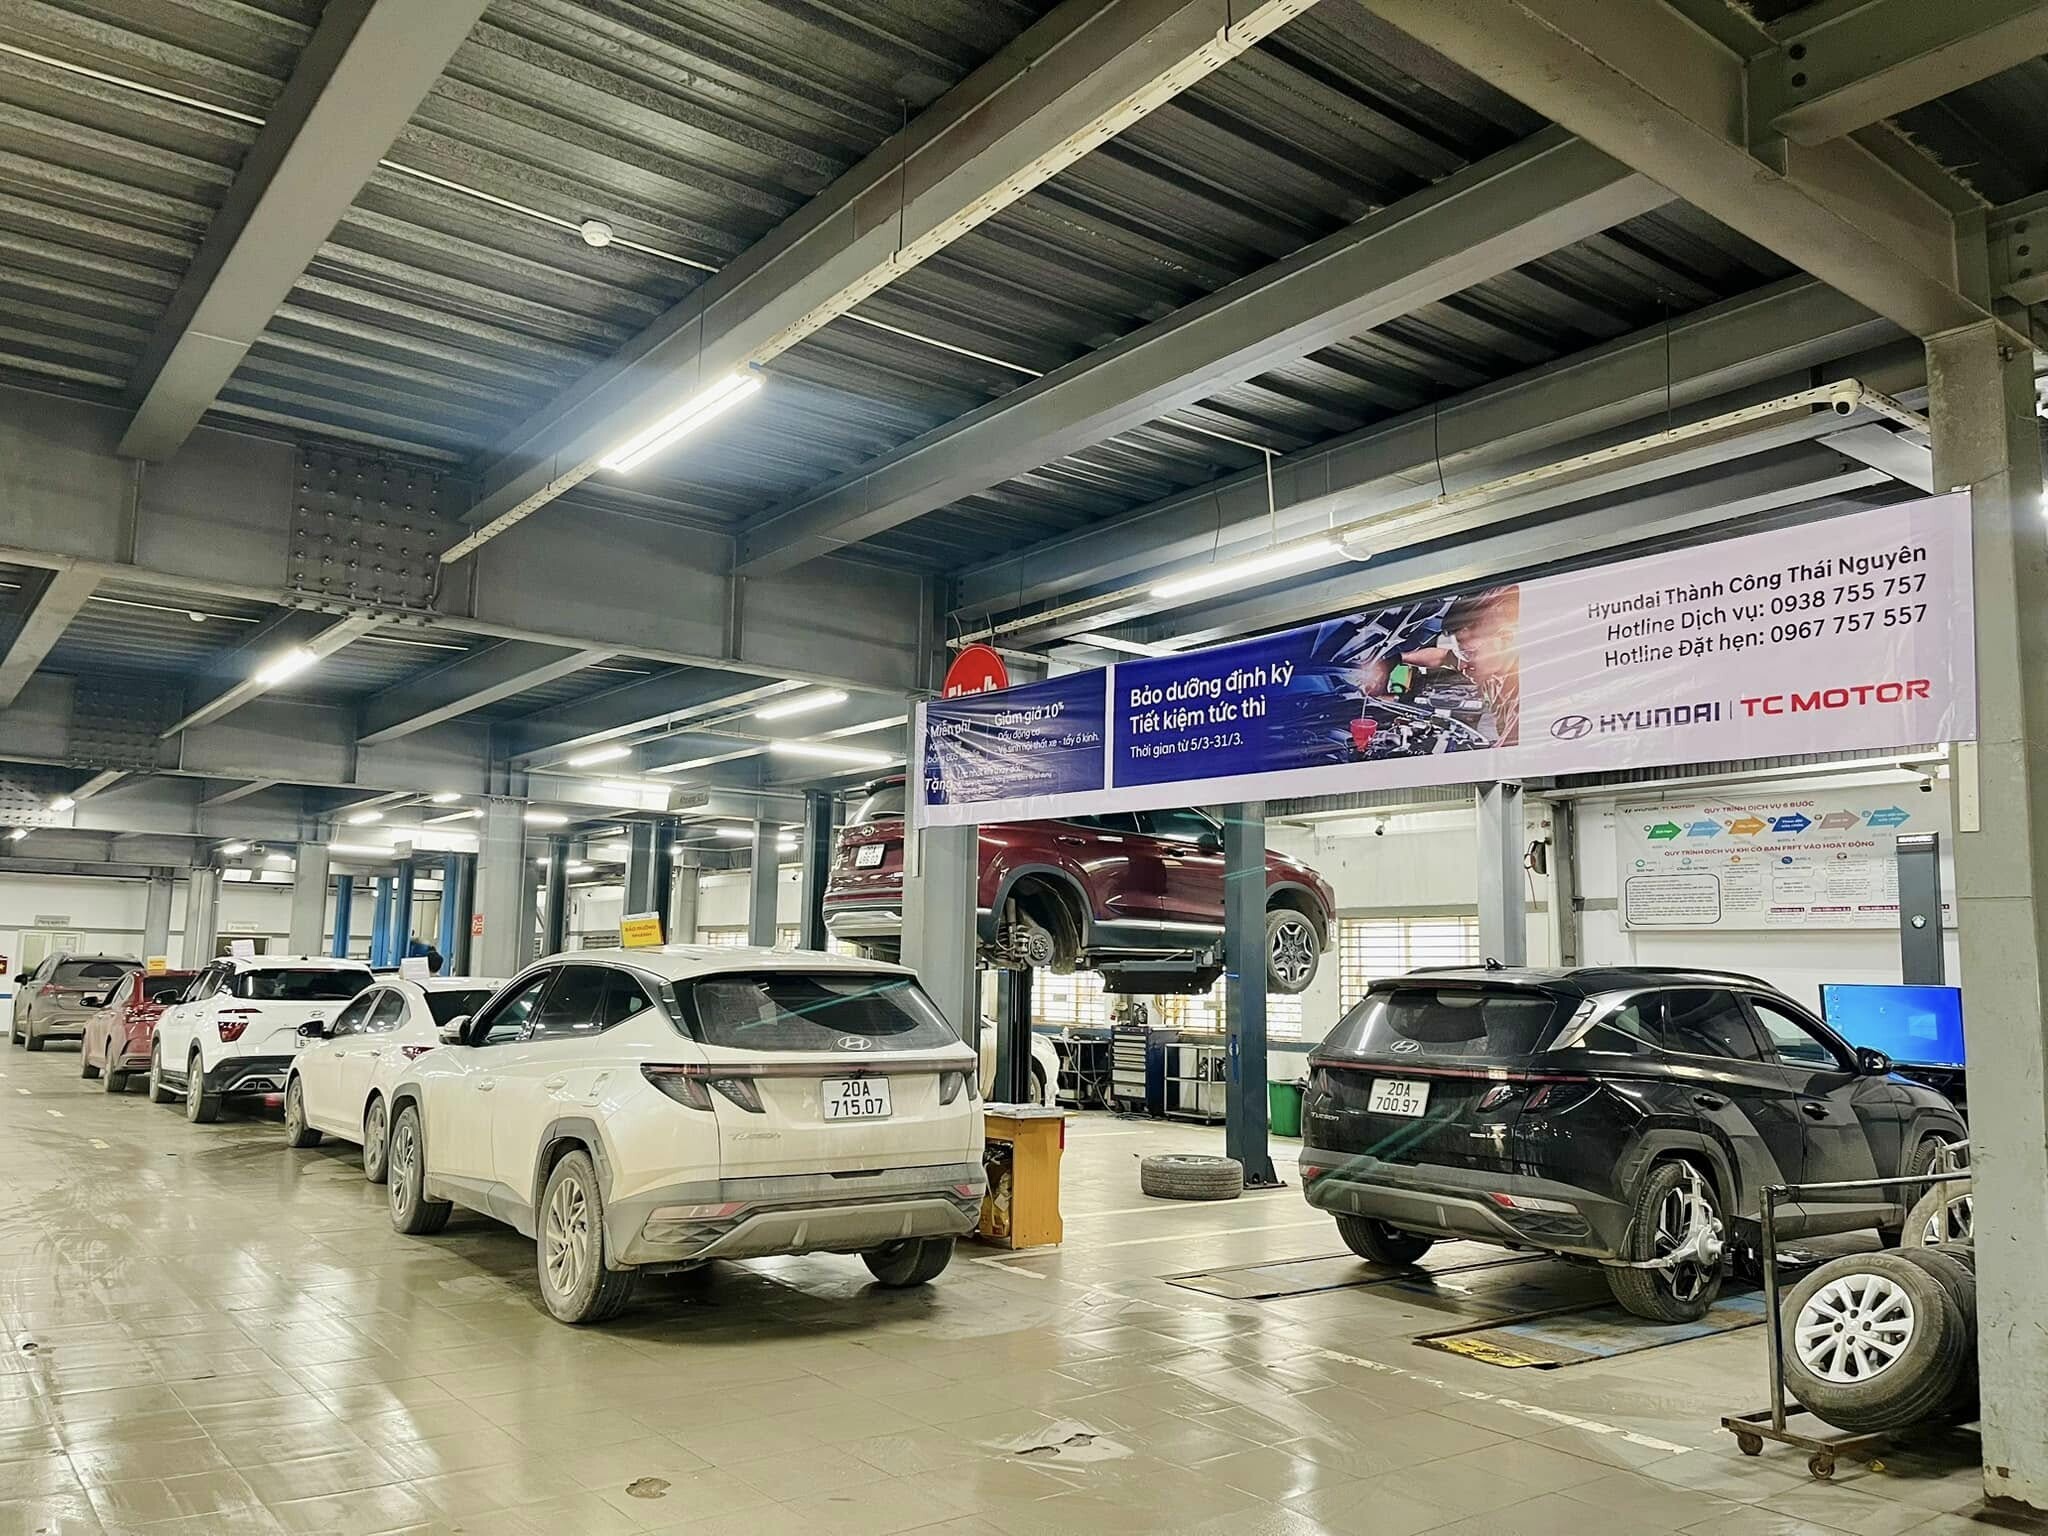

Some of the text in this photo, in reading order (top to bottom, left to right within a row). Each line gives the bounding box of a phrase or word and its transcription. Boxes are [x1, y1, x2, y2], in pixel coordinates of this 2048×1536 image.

[1588, 545, 1927, 619] Hyundai Thành Công Thái Nguyên
[1608, 573, 1927, 641] Hotline Dịch vụ: 0938 755 757
[1605, 604, 1927, 667] Hotline Đặt hẹn: 0967 757 557
[1130, 660, 1294, 707] Bảo dưỡng định kỳ
[1740, 679, 1931, 718] TC MOTOR
[1130, 694, 1266, 735] Tiết kiệm tức thì
[1600, 701, 1721, 734] HYUNDAI
[1130, 732, 1244, 759] Thời gian từ 5/3-31/3.
[831, 1098, 884, 1116] 715.07
[842, 1081, 870, 1097] 20A
[1376, 1096, 1419, 1113] 700.97
[1388, 1082, 1410, 1097] 20A
